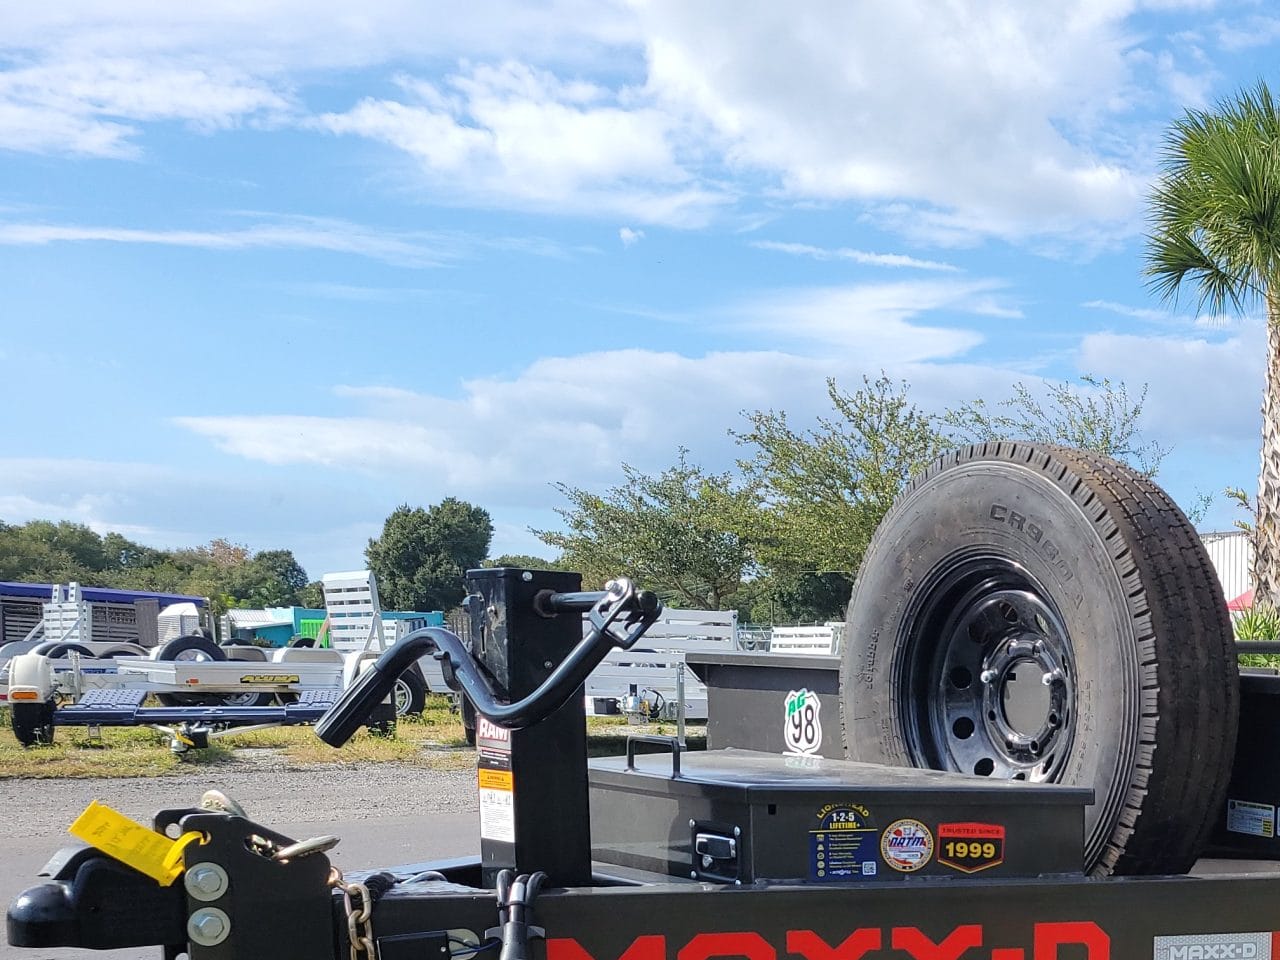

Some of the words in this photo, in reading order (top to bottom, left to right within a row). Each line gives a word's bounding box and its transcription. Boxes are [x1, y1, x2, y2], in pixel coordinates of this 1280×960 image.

[788, 691, 806, 717] AG
[792, 704, 815, 744] 98
[945, 842, 996, 858] 1999
